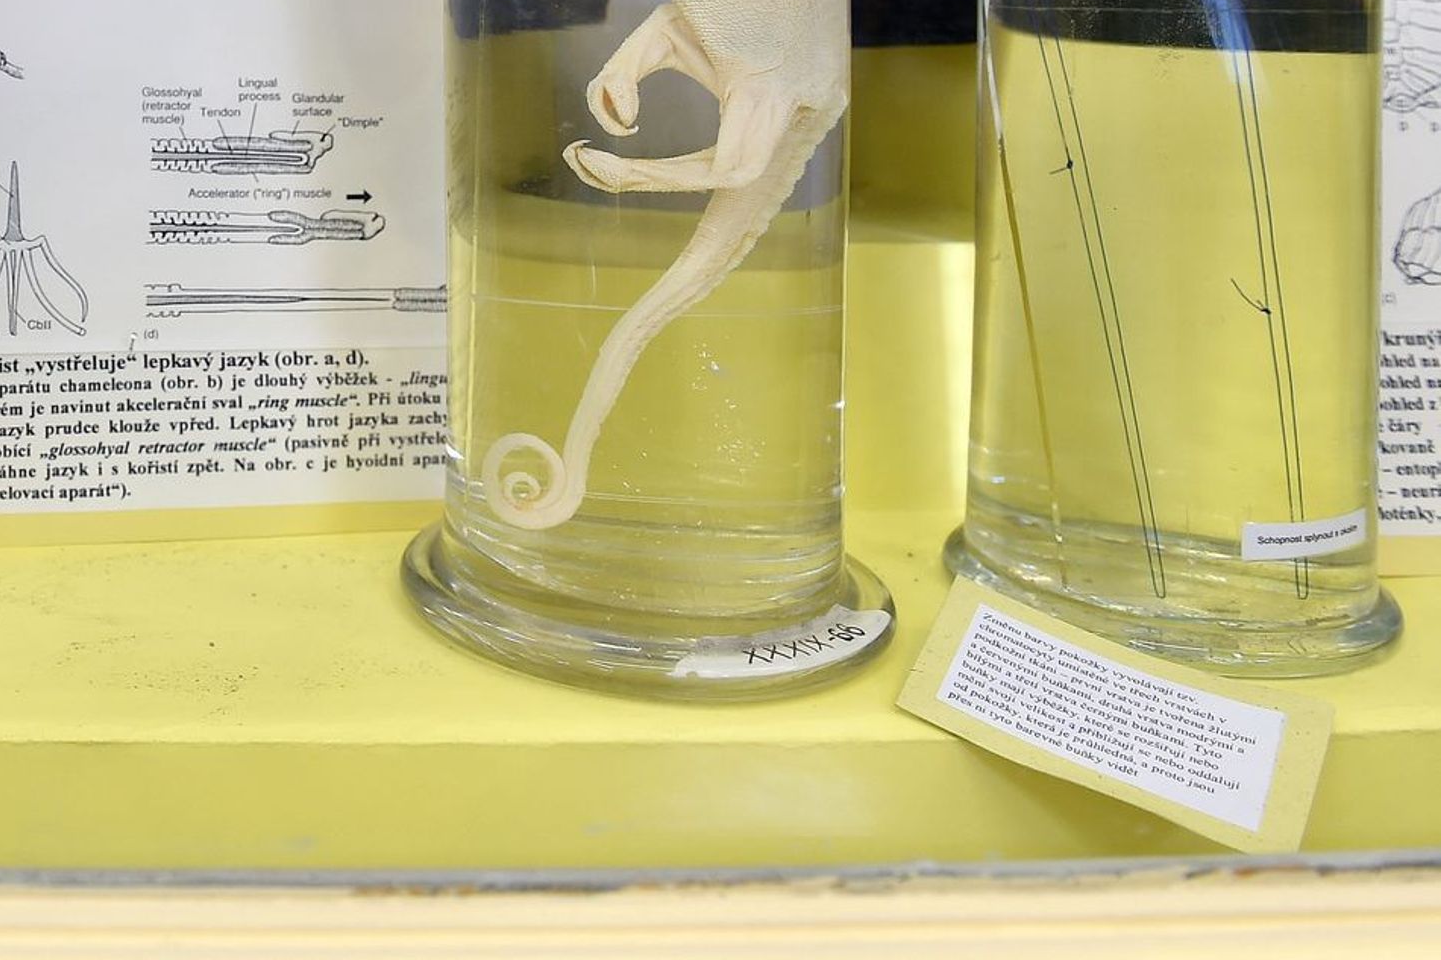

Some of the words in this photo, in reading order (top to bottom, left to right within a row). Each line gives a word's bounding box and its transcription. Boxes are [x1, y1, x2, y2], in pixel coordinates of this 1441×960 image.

[238, 78, 278, 89] Lingual
[142, 87, 202, 99] Glossohyal
[238, 92, 280, 102] process
[292, 93, 344, 104] Glandular
[142, 101, 191, 113] (retractor
[201, 107, 241, 117] Tendon
[293, 108, 332, 117] surface
[142, 115, 185, 126] muscle)
[188, 189, 250, 199] Accelerator
[294, 189, 331, 198] muscle
[143, 329, 159, 340] (d)
[143, 353, 213, 372] lepkavý
[219, 351, 269, 371] jazyk
[275, 351, 318, 368] (obr.
[325, 355, 340, 367] a,
[346, 350, 369, 366] d).
[60, 379, 152, 393] chameleona
[161, 376, 198, 392] (obr.
[208, 375, 223, 390] b)
[231, 375, 246, 391] je
[255, 373, 308, 389] dlouhý
[316, 372, 378, 389] výběžek
[30, 402, 44, 418] je
[51, 401, 111, 414] navinut
[116, 396, 206, 412] akcelerační
[212, 396, 242, 409] sval
[368, 391, 390, 406] Při
[398, 392, 440, 405] útoku
[45, 421, 99, 439] prudce
[109, 419, 160, 433] klouže
[169, 417, 219, 435] vpřed.
[231, 414, 296, 431] Lepkavý
[308, 414, 339, 427] hrot
[348, 413, 398, 429] jazyka
[138, 441, 204, 454] retractor
[285, 435, 349, 452] (pasivně
[358, 432, 380, 449] při
[45, 462, 88, 480] jazyk
[128, 461, 178, 475] kořistí
[187, 458, 224, 476] zpět.
[234, 458, 255, 472] Na
[265, 457, 296, 471] obr.
[323, 456, 337, 472] je
[347, 454, 403, 471] hyoidní
[1194, 743, 1222, 759] Tyto
[1155, 755, 1184, 771] nebo
[1190, 755, 1219, 770] nebo
[1187, 779, 1215, 793] jsou
